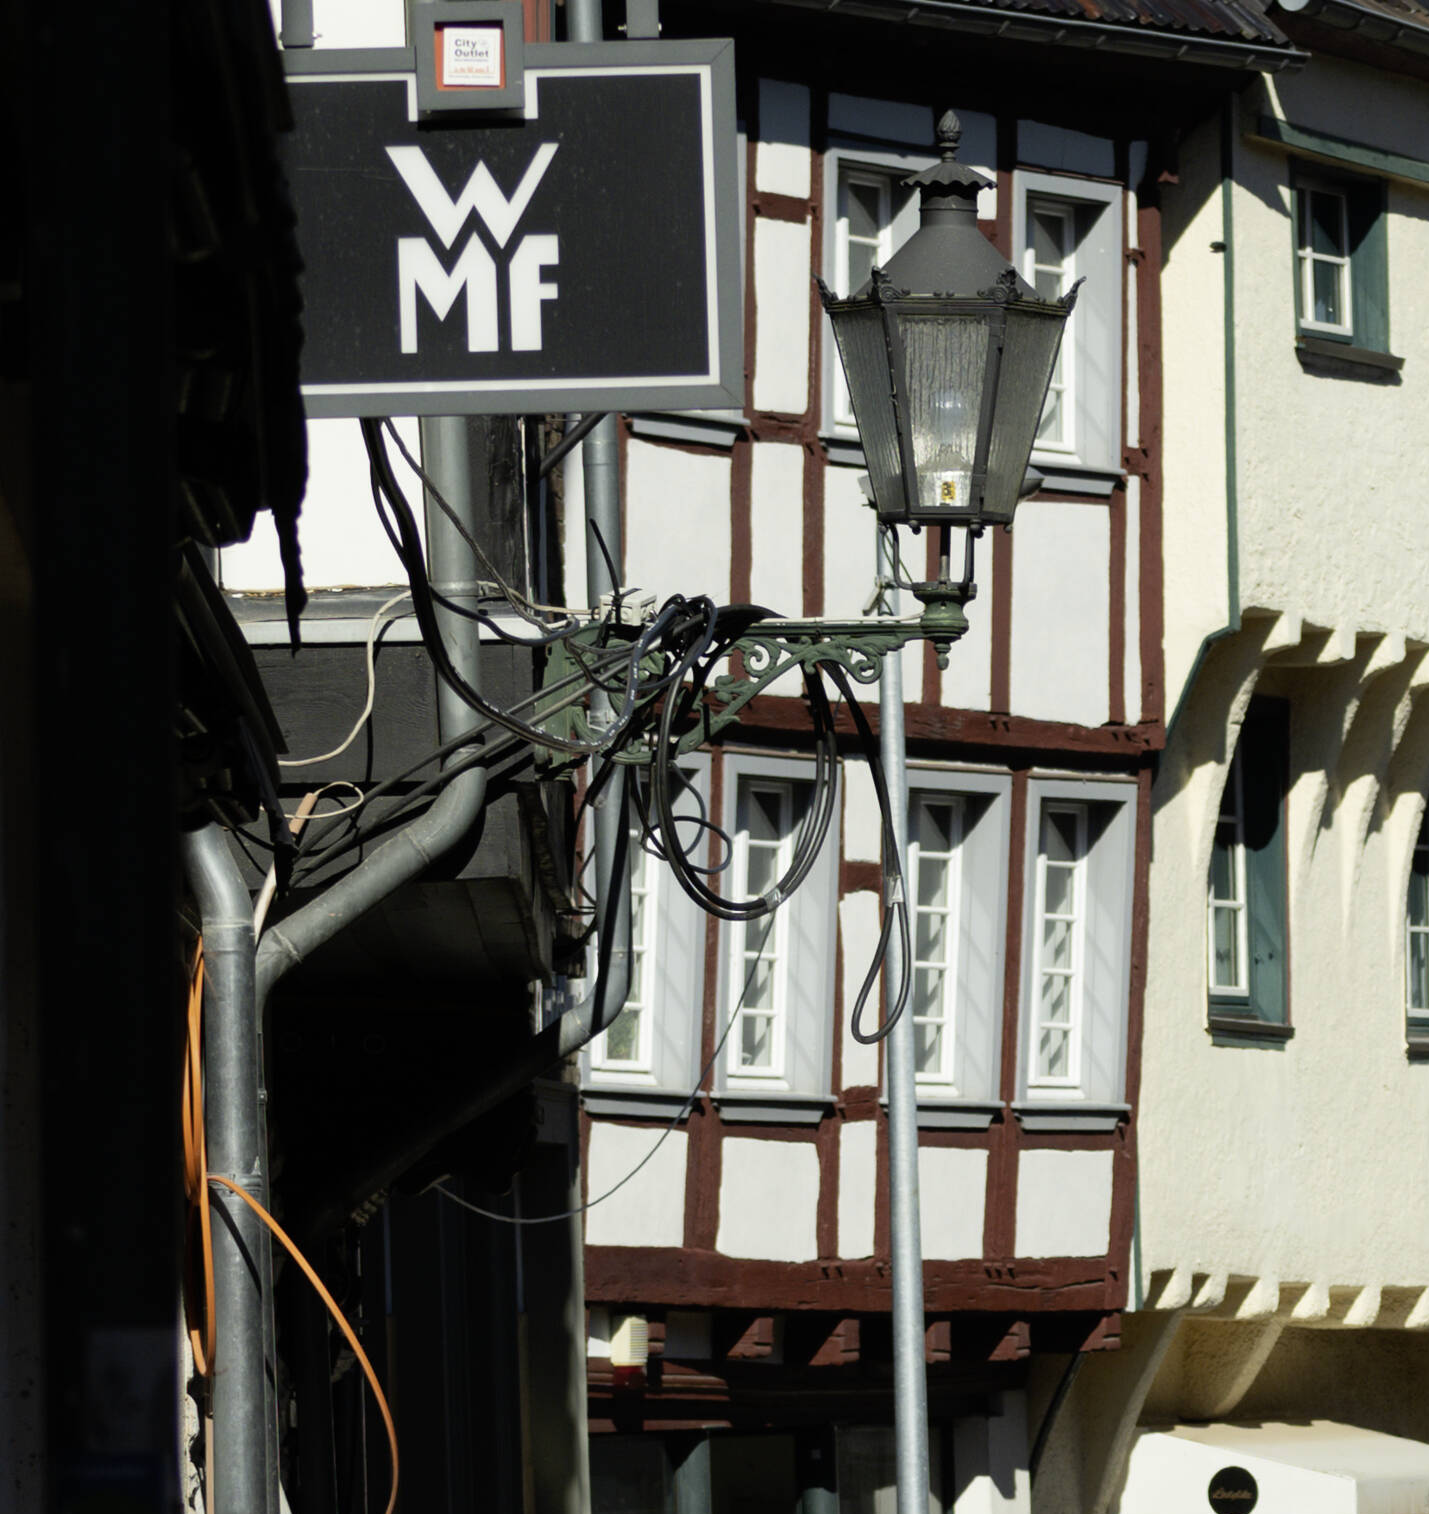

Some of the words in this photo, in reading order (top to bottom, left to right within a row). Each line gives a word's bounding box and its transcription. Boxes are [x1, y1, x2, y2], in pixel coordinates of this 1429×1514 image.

[454, 38, 477, 49] City
[454, 49, 489, 58] Outlet
[385, 142, 560, 355] WMF
